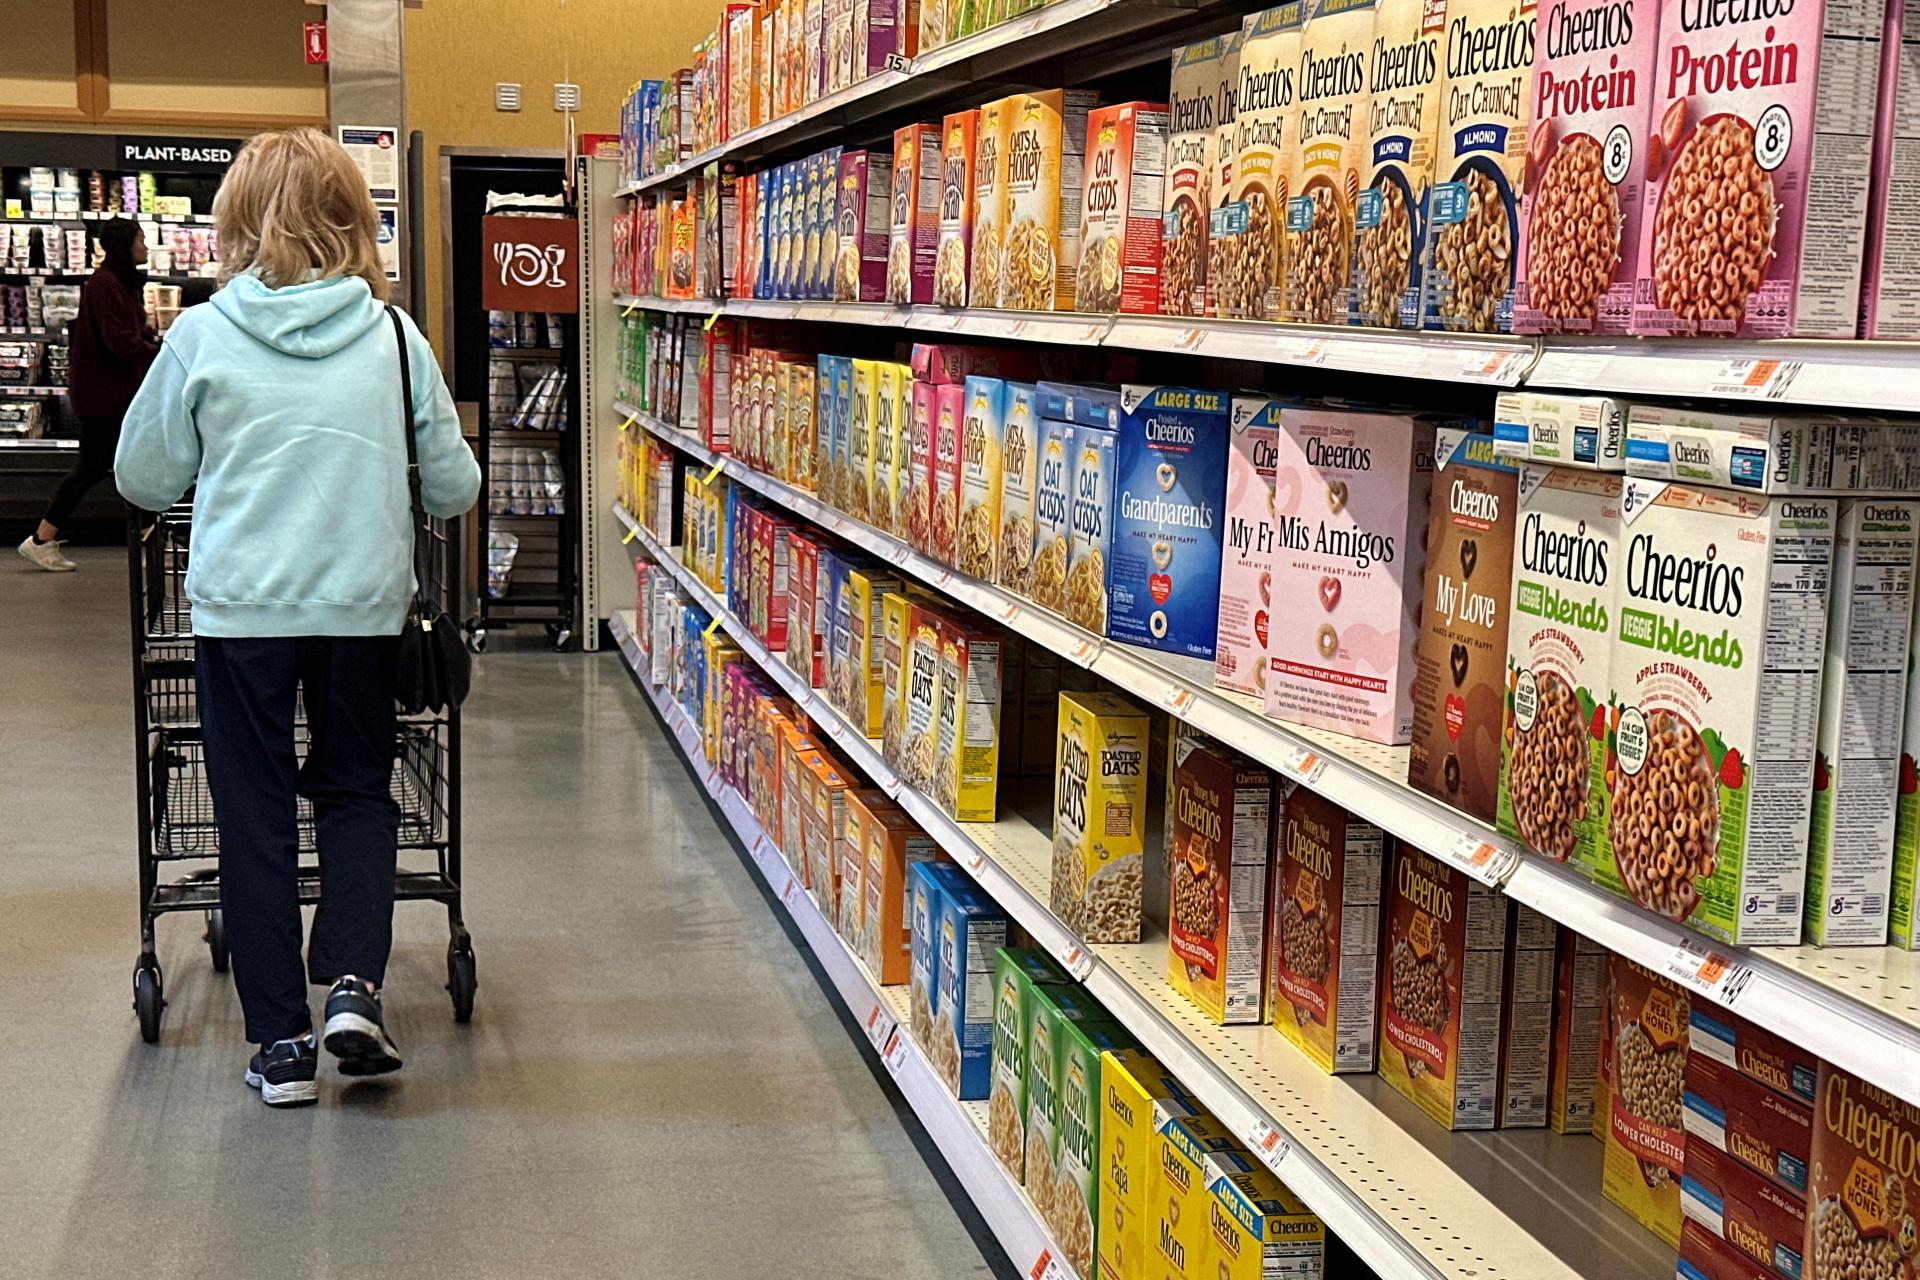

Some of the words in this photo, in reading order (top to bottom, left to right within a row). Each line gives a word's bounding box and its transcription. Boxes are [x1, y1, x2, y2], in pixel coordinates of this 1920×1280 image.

[1260, 11, 1280, 30] LARGE
[1280, 6, 1299, 26] SIZE
[1547, 0, 1634, 60] Cheerios
[1370, 28, 1438, 94] Cheerios
[1446, 6, 1537, 80] Cheerios
[888, 56, 904, 70] 15
[1299, 41, 1364, 102] Cheerios
[1667, 26, 1798, 100] Protein
[1238, 58, 1294, 114] Cheerios
[1450, 85, 1470, 127] OAT
[1472, 77, 1522, 120] CRUNCH
[1536, 54, 1636, 120] Protein
[1169, 86, 1212, 134] Cheerios
[1300, 110, 1316, 144] OAT
[1316, 104, 1352, 140] CRUNCH
[1370, 100, 1385, 138] OAT
[1386, 93, 1424, 132] CRUNCH
[1010, 130, 1031, 152] OATS
[1031, 130, 1042, 150] &
[1252, 116, 1284, 150] CRUNCH
[1379, 142, 1404, 156] ALMOND
[1463, 130, 1496, 146] ALMOND
[1766, 124, 1778, 152] 8
[125, 145, 232, 162] PLANT-BASED
[1008, 151, 1042, 191] Honey
[1096, 148, 1116, 179] OAT
[1612, 142, 1622, 168] 8
[1154, 390, 1190, 409] LARGE
[1194, 394, 1219, 410] SIZE
[1146, 418, 1194, 444] Cheerios
[1533, 424, 1559, 444] Cheerios
[1604, 410, 1620, 458] Cheerios
[1306, 437, 1371, 472] Cheerios
[1675, 442, 1710, 465] Cheerios
[1774, 430, 1792, 483] Cheerios
[1044, 458, 1062, 490] OAT
[1080, 468, 1099, 500] OAT
[1122, 490, 1213, 531] Grandparents
[1450, 480, 1498, 522] Cheerios
[1781, 502, 1828, 519] Cheerios
[1864, 506, 1910, 522] Cheerios
[1229, 516, 1253, 558] My
[1278, 514, 1310, 552] Mis
[1315, 520, 1394, 569] Amigos
[1522, 513, 1608, 587] Cheerios
[1738, 528, 1756, 541] Gluten
[1756, 531, 1766, 544] Free
[1774, 538, 1806, 546] Nutrition
[1812, 538, 1830, 546] Facts
[1858, 540, 1890, 548] Nutrition
[1893, 540, 1912, 548] Facts
[1292, 562, 1306, 570] MAKE
[1308, 563, 1321, 572] MY
[1323, 565, 1345, 576] HEART
[1348, 568, 1372, 580] HAPPY
[1626, 534, 1744, 618] Cheerios
[1796, 580, 1810, 590] 170
[1812, 580, 1826, 590] 230
[1880, 582, 1893, 592] 170
[1896, 582, 1908, 592] 230
[1436, 574, 1459, 627] My
[1460, 581, 1496, 628] Love
[1519, 584, 1542, 616] VEGGIE
[1544, 586, 1608, 633] blends
[1528, 628, 1546, 648] APPLE
[1546, 628, 1584, 665] STRAWBERRY
[1624, 614, 1654, 641] VEGGIE
[1657, 615, 1743, 670] blends
[912, 671, 933, 707] OATS
[1273, 661, 1287, 671] GOOD
[1287, 665, 1314, 676] MORNINGS
[1314, 670, 1330, 679] START
[1330, 673, 1343, 682] WITH
[1344, 676, 1362, 685] HAPPY
[1362, 680, 1386, 691] HEARTS
[1636, 662, 1658, 685] APPLE
[1660, 662, 1713, 704] STRAWBERRY
[1620, 732, 1638, 745] FRUIT
[1638, 738, 1644, 747] &
[1621, 721, 1630, 731] 1/4
[1631, 724, 1644, 736] CUP
[1062, 734, 1090, 784] TOASTED
[1101, 750, 1142, 762] TOASTED
[1102, 761, 1140, 776] OATS
[1618, 742, 1642, 761] VEGGIES
[1236, 773, 1269, 784] Cheerios
[1058, 767, 1087, 832] OATS
[1178, 786, 1221, 842] Cheerios
[1286, 818, 1332, 880] Cheerios
[1399, 856, 1452, 924] Cheerios
[1410, 930, 1430, 952] HONEY
[1414, 919, 1428, 940] REAL
[1278, 974, 1292, 993] LOWER
[1292, 984, 1326, 1011] CHOLESTEROL
[1000, 998, 1018, 1038] CORN
[1645, 1012, 1675, 1037] HONEY
[1650, 1002, 1671, 1022] REAL
[1034, 1038, 1051, 1081] CORN
[1386, 1018, 1404, 1042] LOWER
[1404, 1035, 1444, 1064] CHOLESTEROL
[1742, 1048, 1788, 1090] Cheerios
[1066, 1078, 1088, 1124] CORN
[1108, 1084, 1134, 1128] Cheerios
[1168, 1122, 1189, 1155] LARGE
[1189, 1142, 1204, 1168] SIZE
[1614, 1118, 1638, 1144] LOWER
[1638, 1120, 1650, 1132] CAN
[1650, 1124, 1668, 1138] HELP
[1162, 1142, 1190, 1190] Cheerios
[1730, 1132, 1774, 1176] Cheerios
[1110, 1154, 1128, 1195] Papá
[1855, 1174, 1880, 1200] REAL
[1218, 1181, 1238, 1212] LARGE
[1238, 1203, 1254, 1232] SIZE
[1848, 1188, 1885, 1221] HONEY
[1160, 1218, 1185, 1271] Mom
[1212, 1200, 1240, 1254] Cheerios
[1270, 1220, 1319, 1235] Cheerios
[1728, 1220, 1772, 1266] Cheerios
